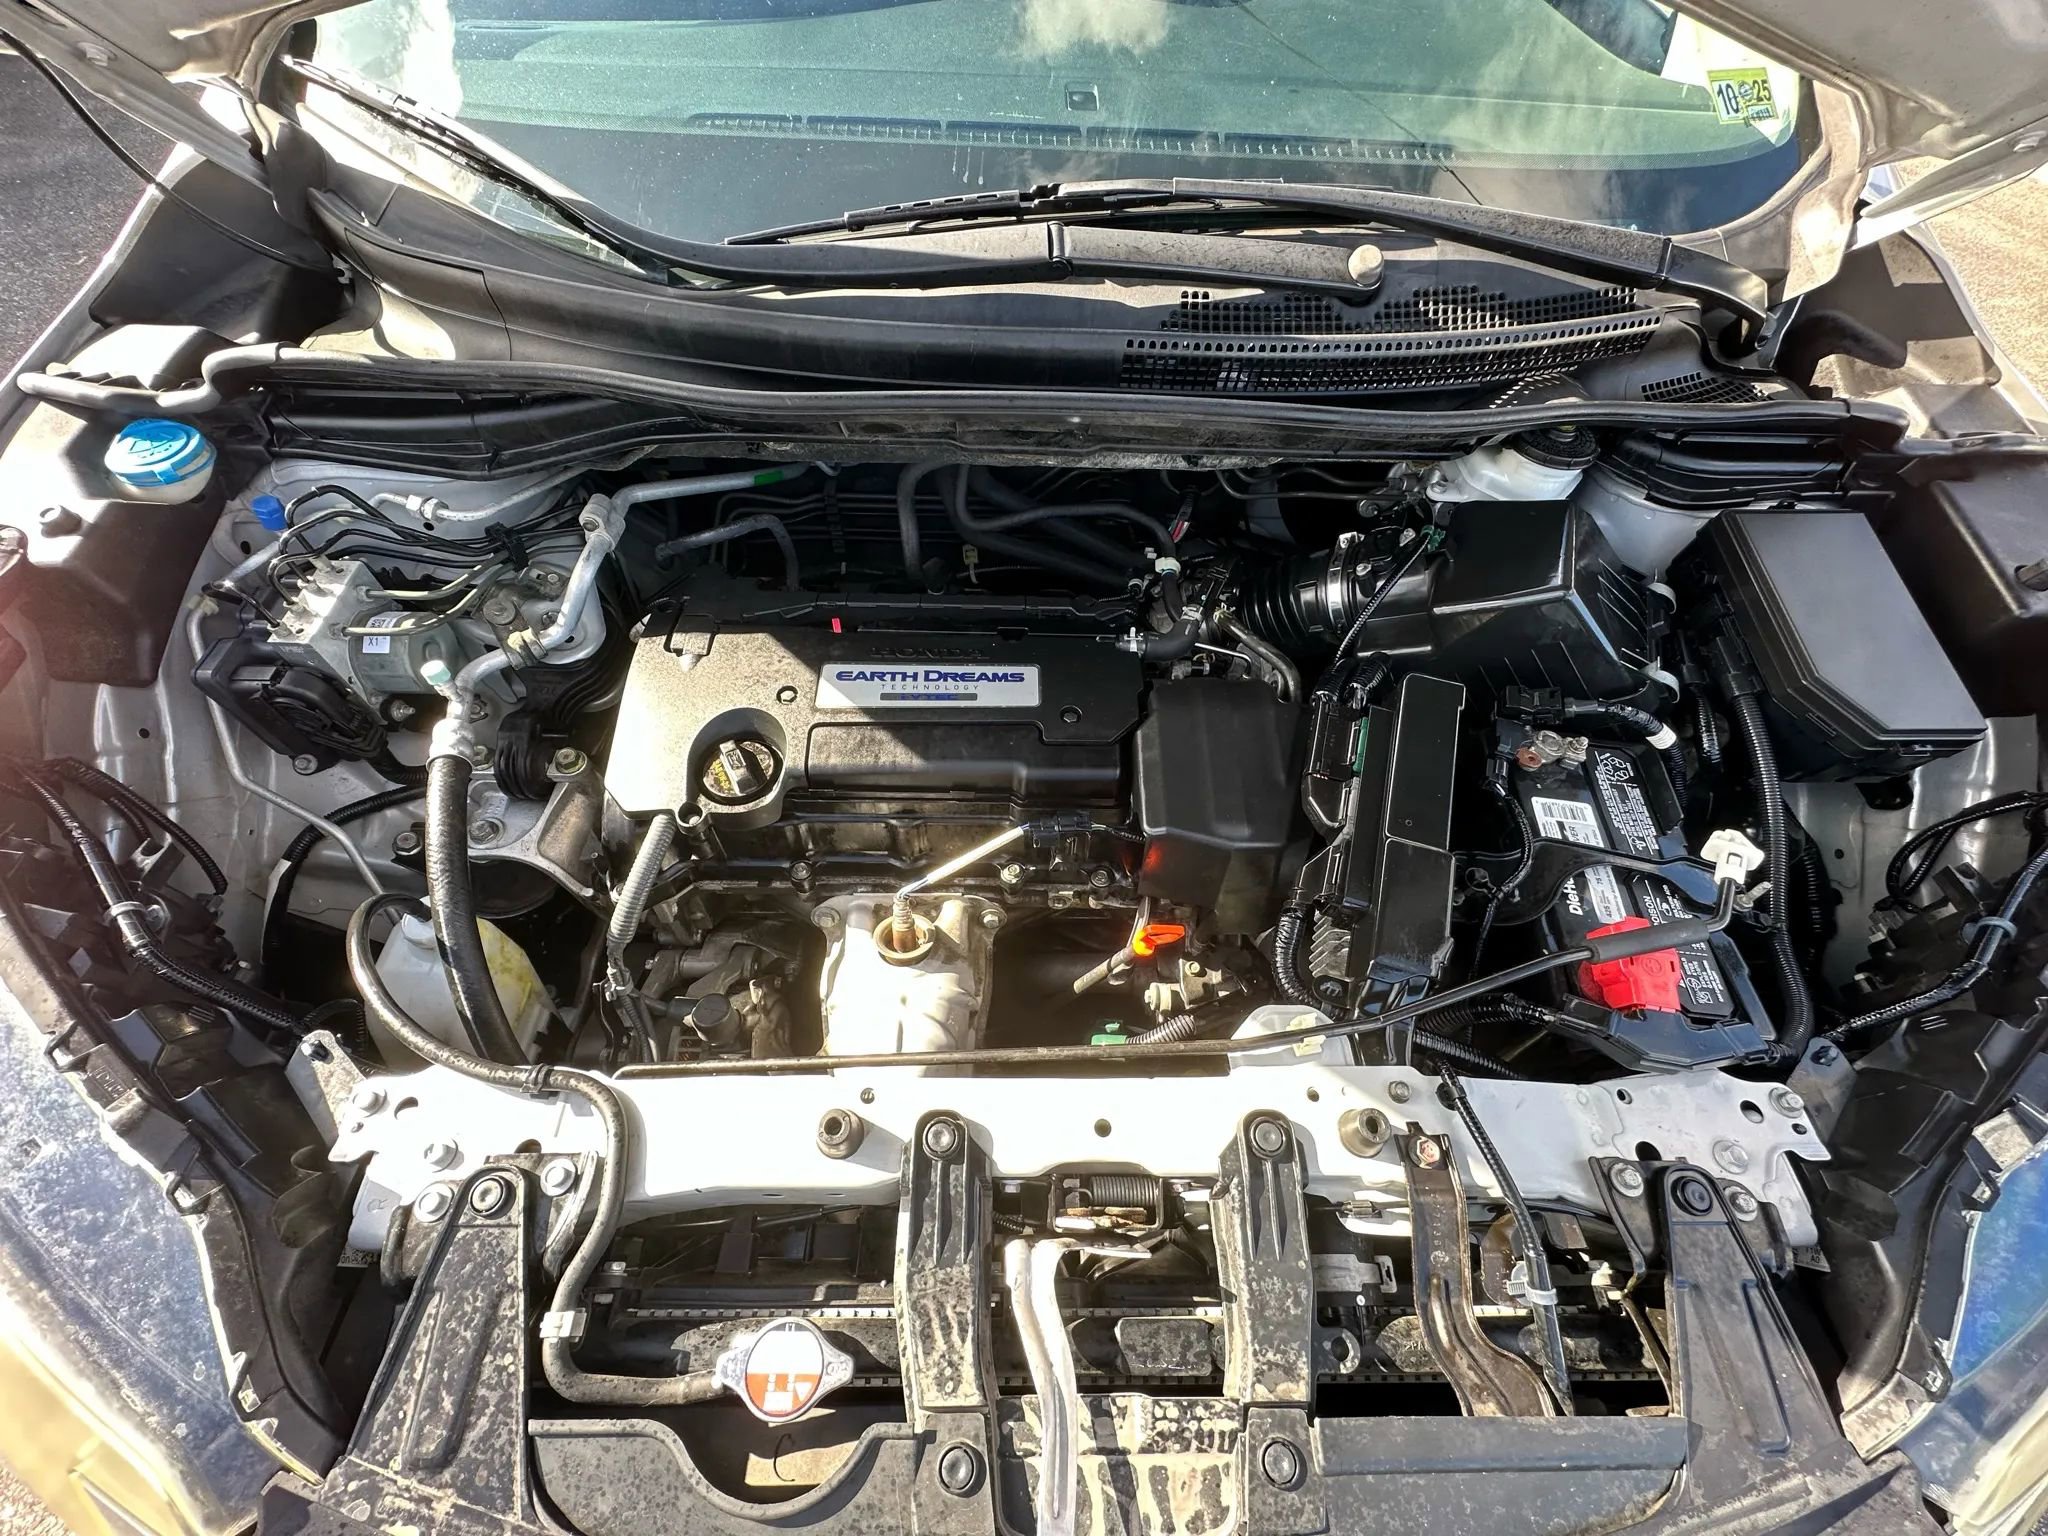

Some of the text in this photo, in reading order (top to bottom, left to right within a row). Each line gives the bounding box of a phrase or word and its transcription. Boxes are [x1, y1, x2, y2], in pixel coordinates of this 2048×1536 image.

[1717, 83, 1739, 115] 10
[1752, 79, 1771, 102] 25
[368, 636, 379, 646] X1
[836, 670, 1025, 682] EARTH DREAMS
